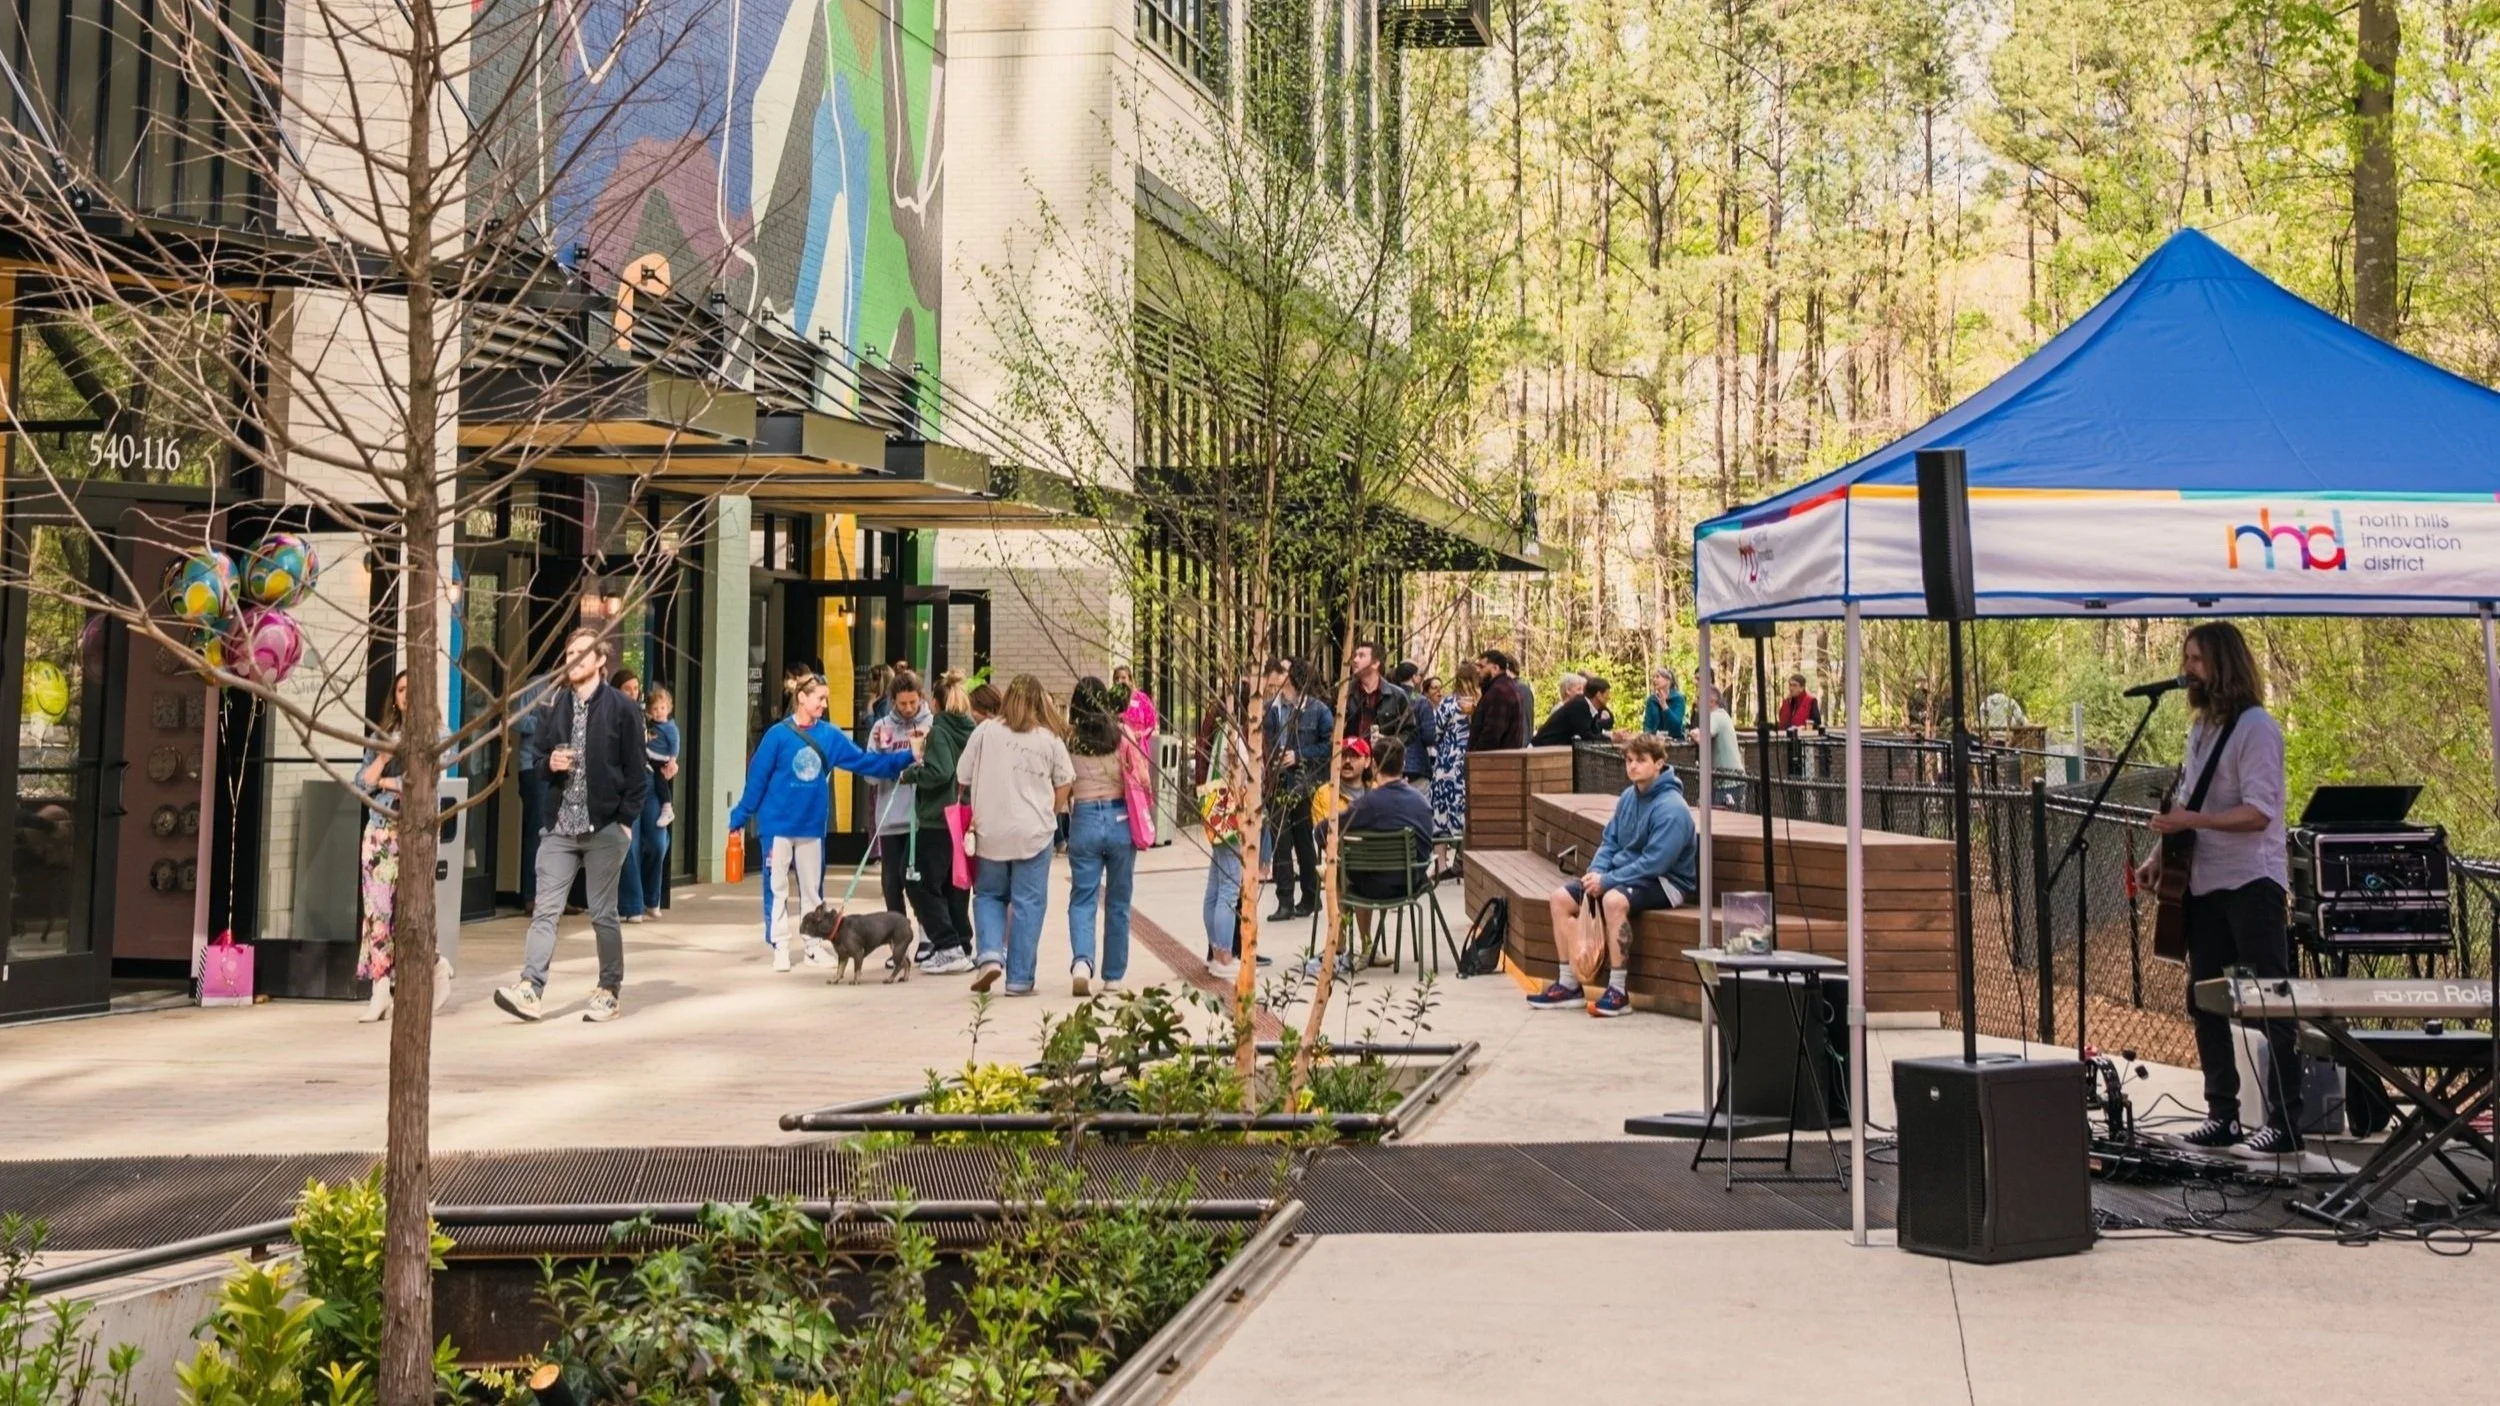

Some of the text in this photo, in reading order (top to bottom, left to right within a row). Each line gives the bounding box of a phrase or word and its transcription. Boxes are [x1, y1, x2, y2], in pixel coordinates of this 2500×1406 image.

[87, 432, 181, 471] 540-116
[2360, 513, 2449, 529] north hills
[2361, 532, 2462, 550] innovation
[2364, 554, 2424, 571] district
[2443, 985, 2494, 1003] Rola
